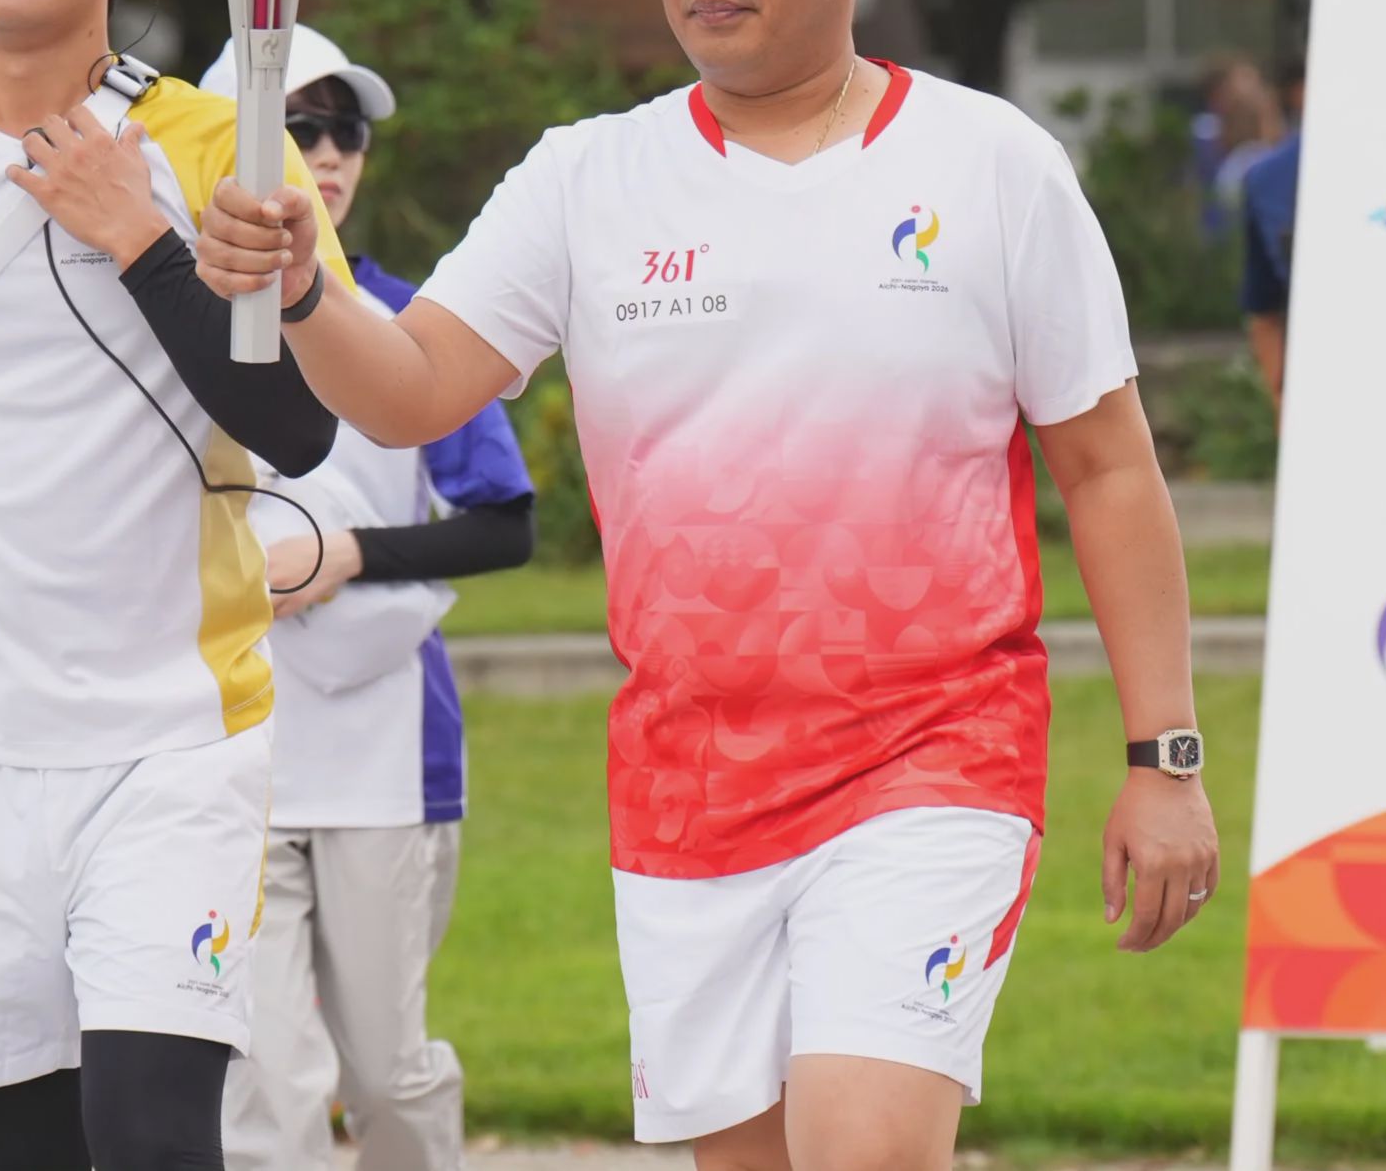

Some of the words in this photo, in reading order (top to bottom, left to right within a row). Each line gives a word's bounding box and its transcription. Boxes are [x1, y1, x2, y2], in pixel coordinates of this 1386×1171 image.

[878, 283, 930, 292] Aichi-Nagoya
[616, 300, 662, 322] 0917
[669, 297, 692, 316] A1
[702, 294, 727, 313] 08
